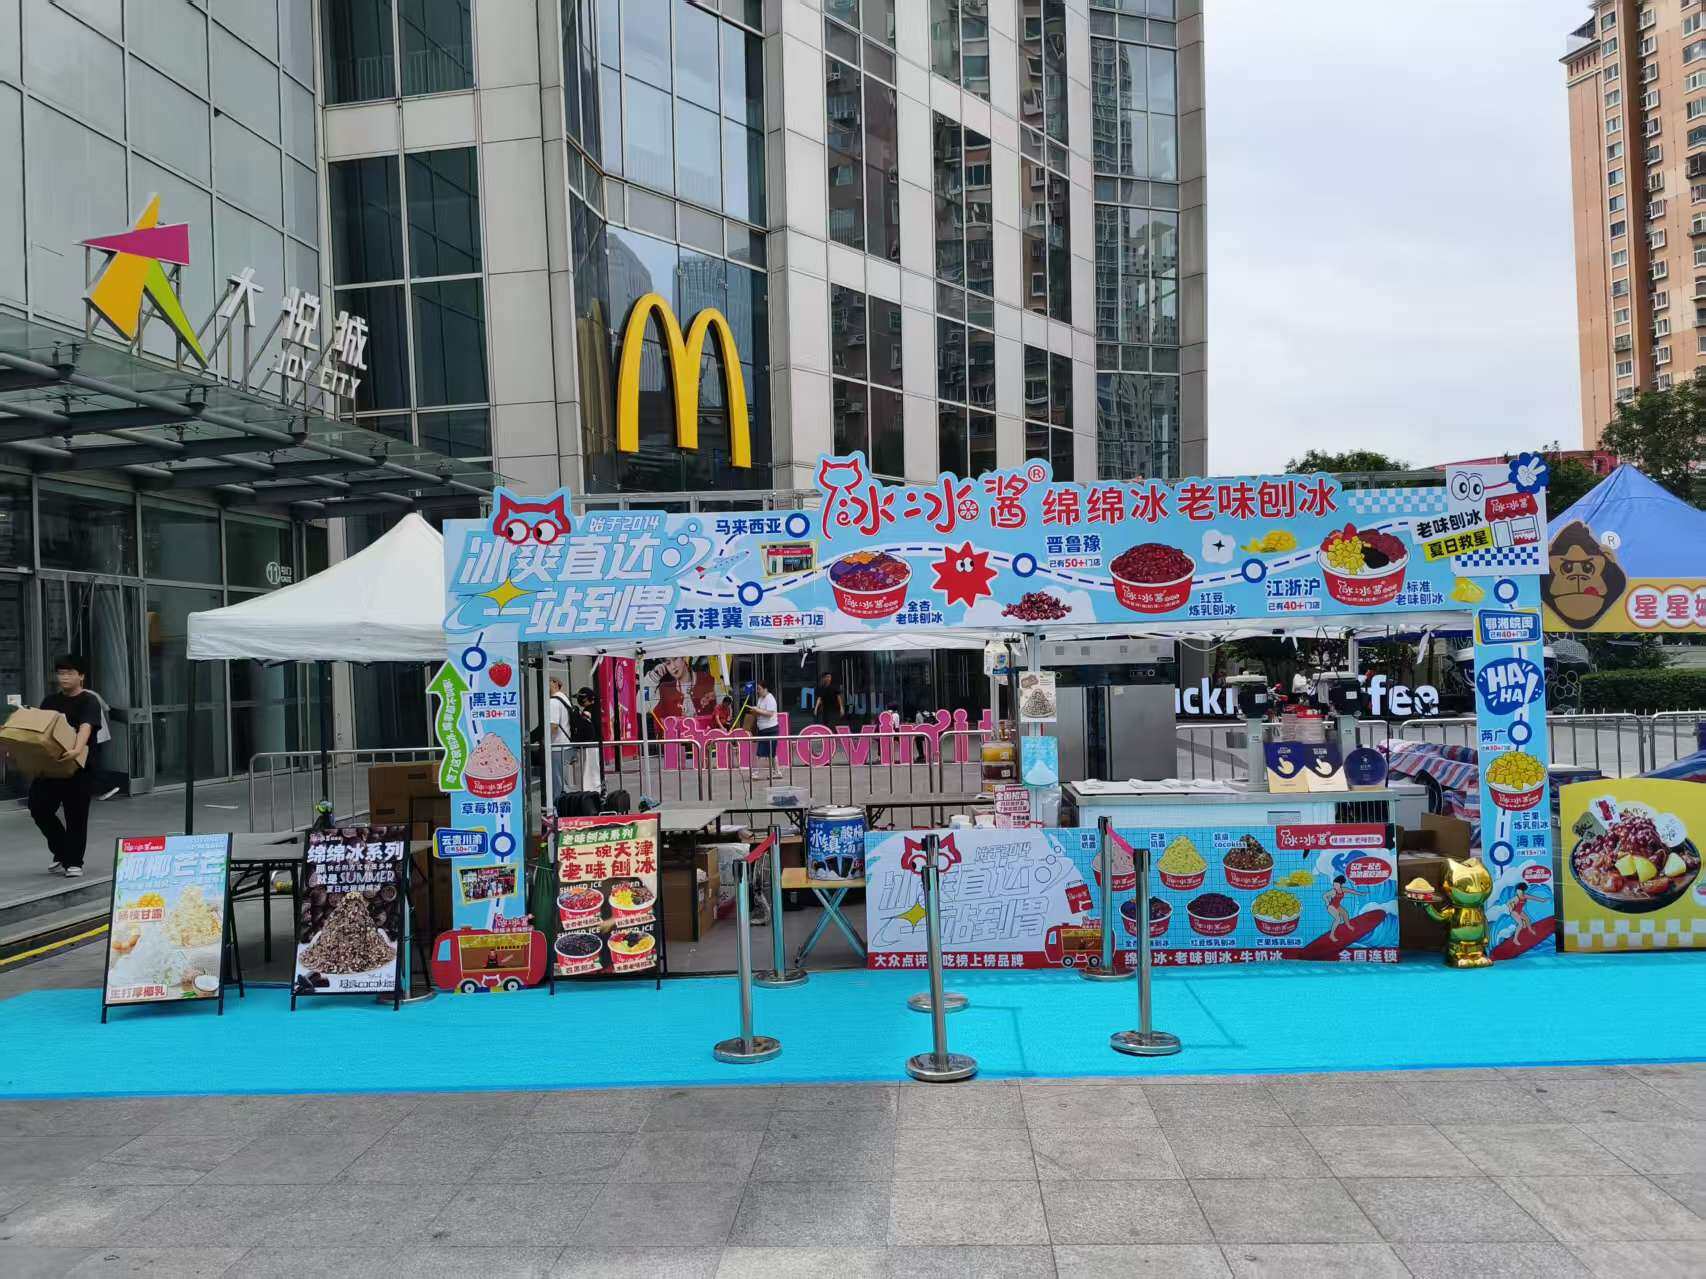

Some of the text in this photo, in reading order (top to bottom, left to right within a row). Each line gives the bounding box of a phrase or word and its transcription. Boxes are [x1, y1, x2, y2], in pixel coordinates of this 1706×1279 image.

[217, 267, 369, 371] 大悦城
[273, 351, 361, 399] JOY CITY
[1042, 478, 1340, 526] 绵绵冰 老味刨冰
[589, 515, 660, 531] 始于2014
[715, 518, 783, 535] 马来西亚
[1417, 509, 1482, 538] 老味刨冰
[1046, 535, 1101, 553] 晋鲁豫
[1428, 530, 1489, 558] 夏日救星
[459, 532, 661, 584] 冰爽直达
[1266, 579, 1321, 596] 江浙沪
[1407, 581, 1431, 593] 标准
[1200, 592, 1223, 604] 红豆
[1268, 600, 1321, 611] 已有40+门店
[1396, 593, 1444, 606] 老味刨冰
[483, 585, 674, 634] 一站到胃
[674, 607, 743, 629] 京津冀
[1189, 604, 1237, 617] 炼乳刨冰
[896, 612, 943, 625] 老味刨冰
[1486, 662, 1526, 693] HA
[473, 691, 517, 706] 黑吉辽
[1481, 729, 1506, 742] 两广
[563, 828, 634, 845] 老味刨冰系列
[1517, 834, 1545, 847] 海南
[307, 841, 404, 863] 绵绵冰系列
[560, 840, 655, 862] 来一碗天津
[340, 870, 396, 883] SUMMER
[563, 858, 657, 881] 老味刨冰
[875, 954, 1025, 968] 大众点评吃榜上榜品牌
[1124, 950, 1283, 964] 绵冰·老味刨冰·牛奶冰
[1339, 950, 1398, 963] 全国连锁
